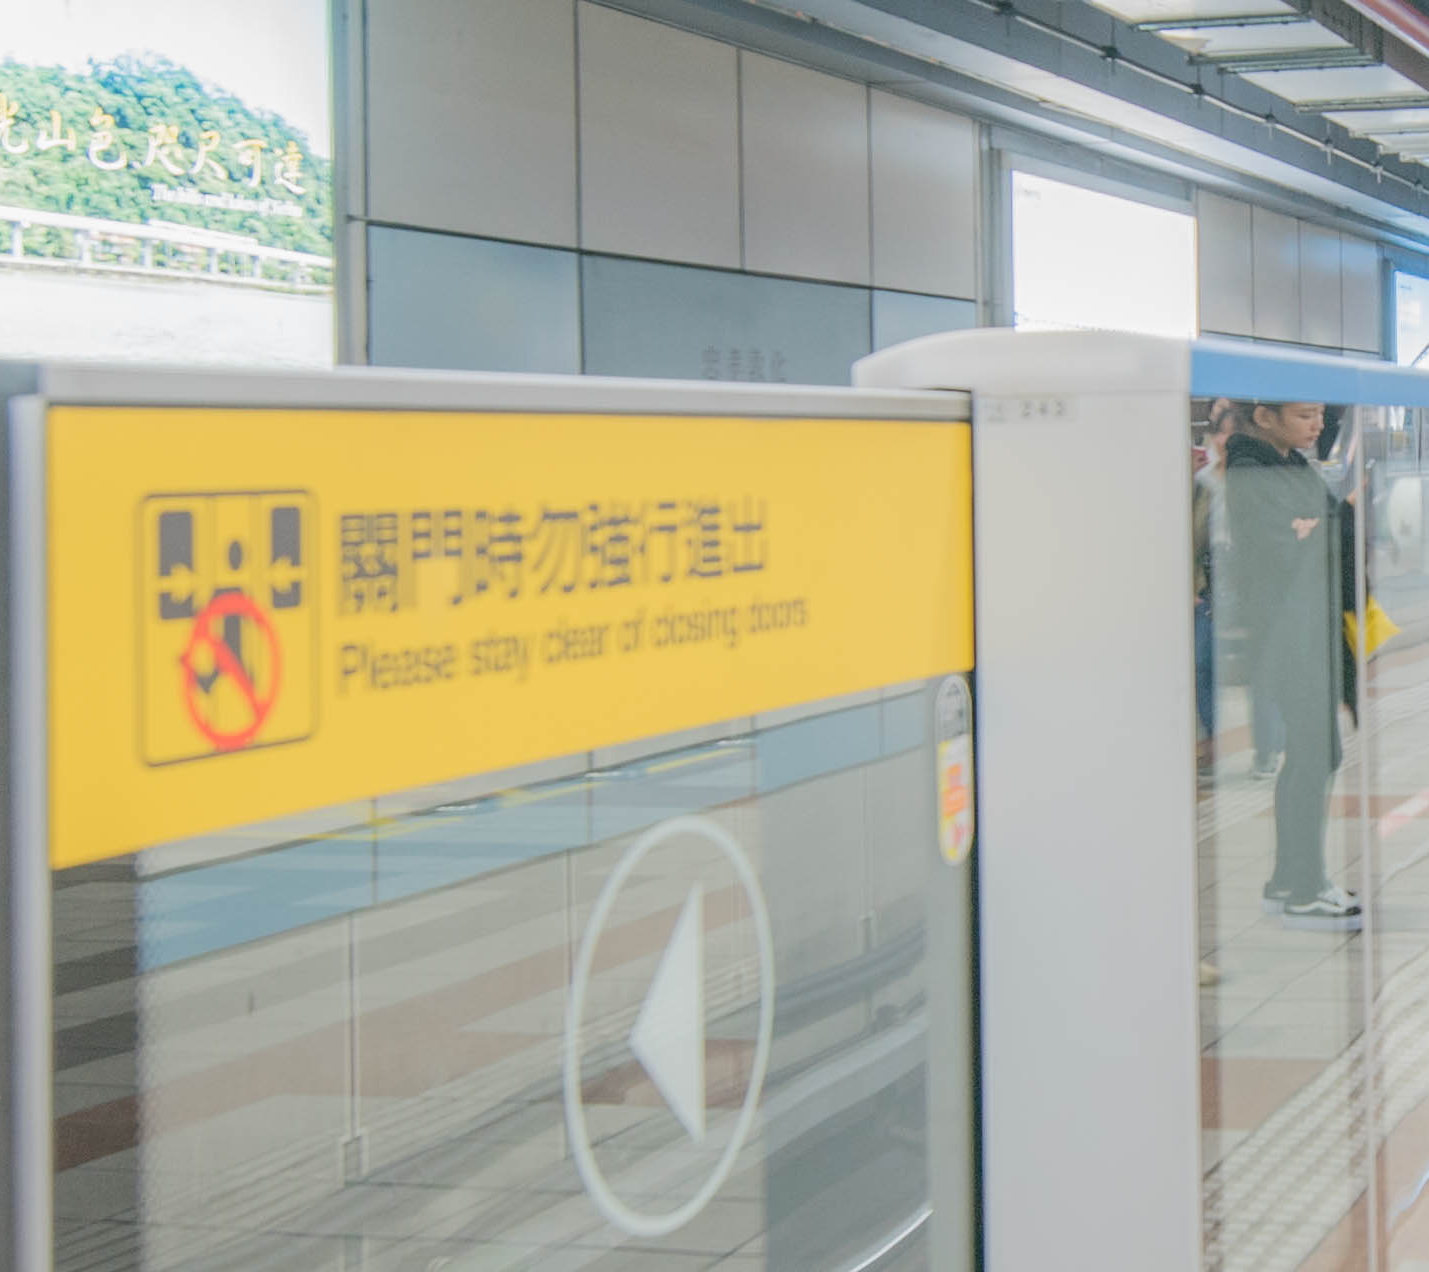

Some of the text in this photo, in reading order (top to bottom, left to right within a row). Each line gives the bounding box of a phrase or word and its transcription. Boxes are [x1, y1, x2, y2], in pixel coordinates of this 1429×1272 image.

[337, 496, 766, 617] 關門時勿強行進出
[337, 593, 809, 699] Please stay clear of closing doors
